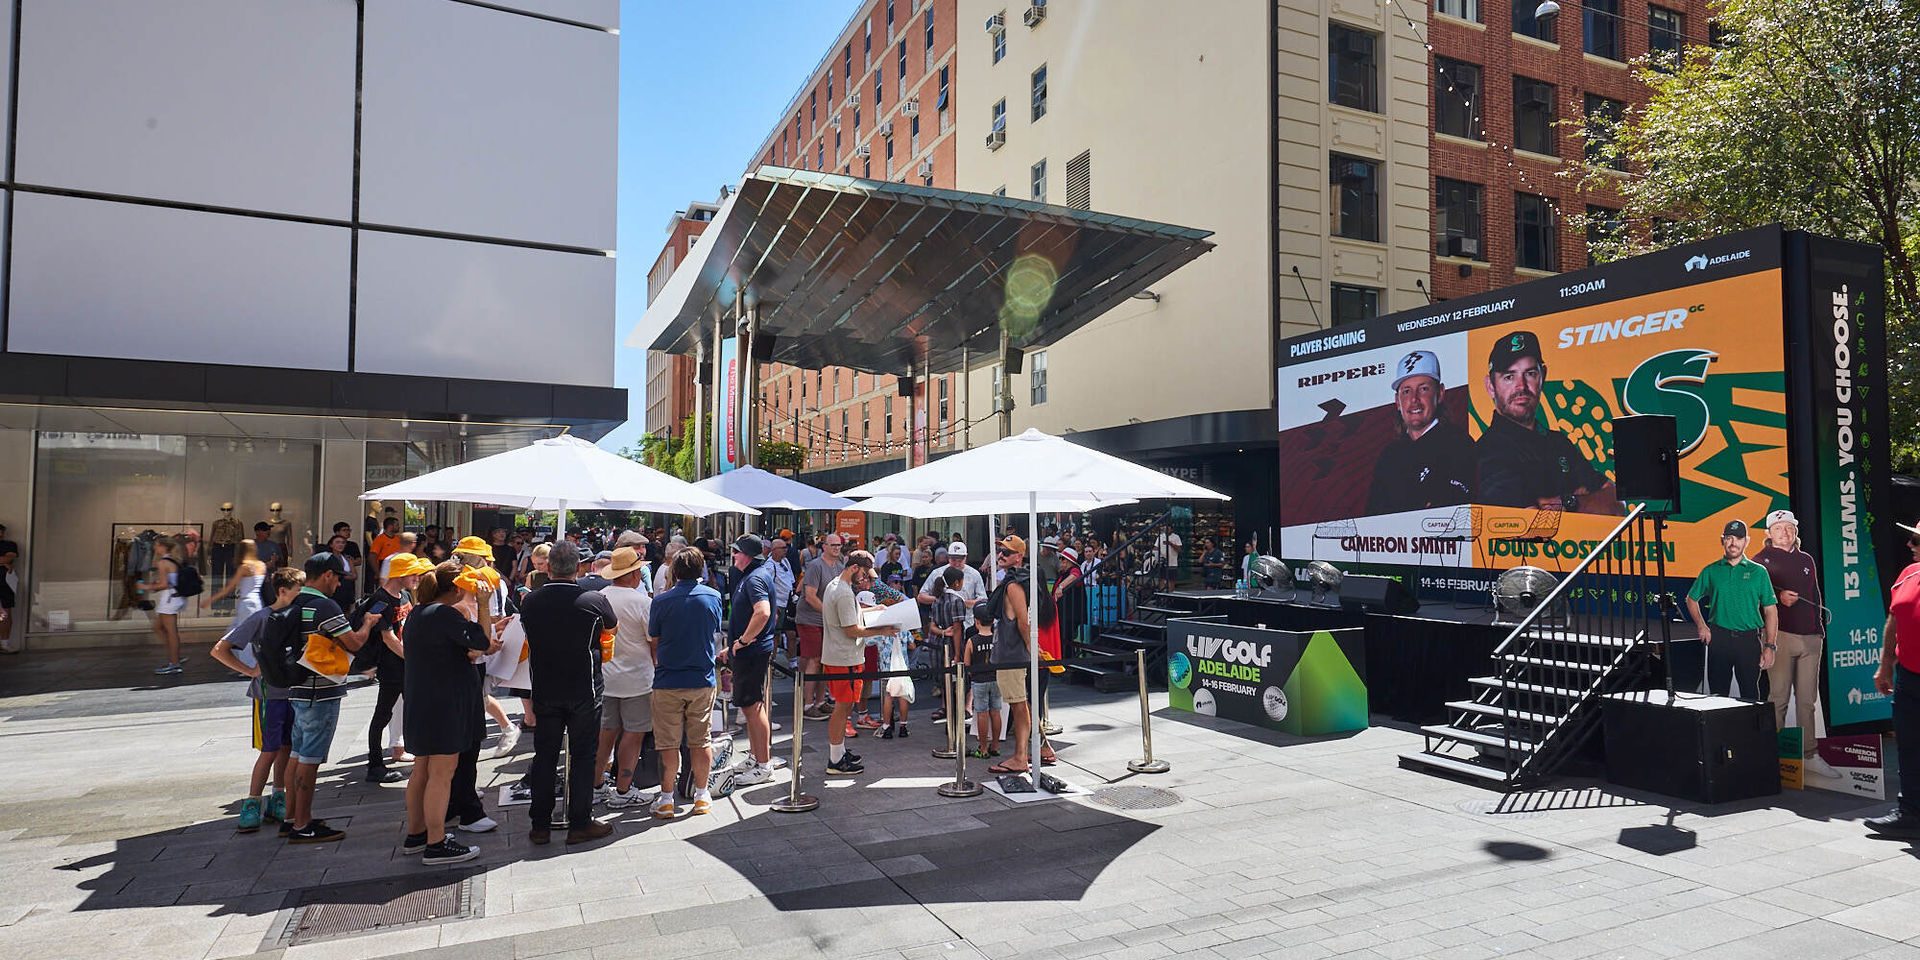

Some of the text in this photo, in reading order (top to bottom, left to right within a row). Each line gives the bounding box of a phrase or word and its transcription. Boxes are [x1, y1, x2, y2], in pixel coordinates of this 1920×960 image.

[1709, 249, 1751, 266] ADELAIDE
[1559, 278, 1606, 298] 11:30AM
[1397, 299, 1516, 332] WEDNESDAY 12 FEBRUARY
[1557, 303, 1705, 349] STINGER GC
[1290, 329, 1366, 358] PLAYER SIGNING
[1298, 365, 1377, 388] RIPPER
[1832, 284, 1860, 600] 13 TEAMS. YOU CHOOSE.
[1341, 536, 1457, 555] CAMERON SMITH
[1488, 538, 1539, 557] LOUIS
[1420, 577, 1497, 592] 14-16 FEBRUA
[1849, 628, 1877, 645] 14-16
[1186, 634, 1272, 668] LIV GOLF
[1833, 648, 1885, 668] FEBRUA
[1197, 660, 1261, 682] ADELAIDE
[1201, 678, 1258, 696] 14-16 FEBRUARY
[1844, 747, 1877, 757] CAMERON
[1857, 755, 1878, 763] SMITH
